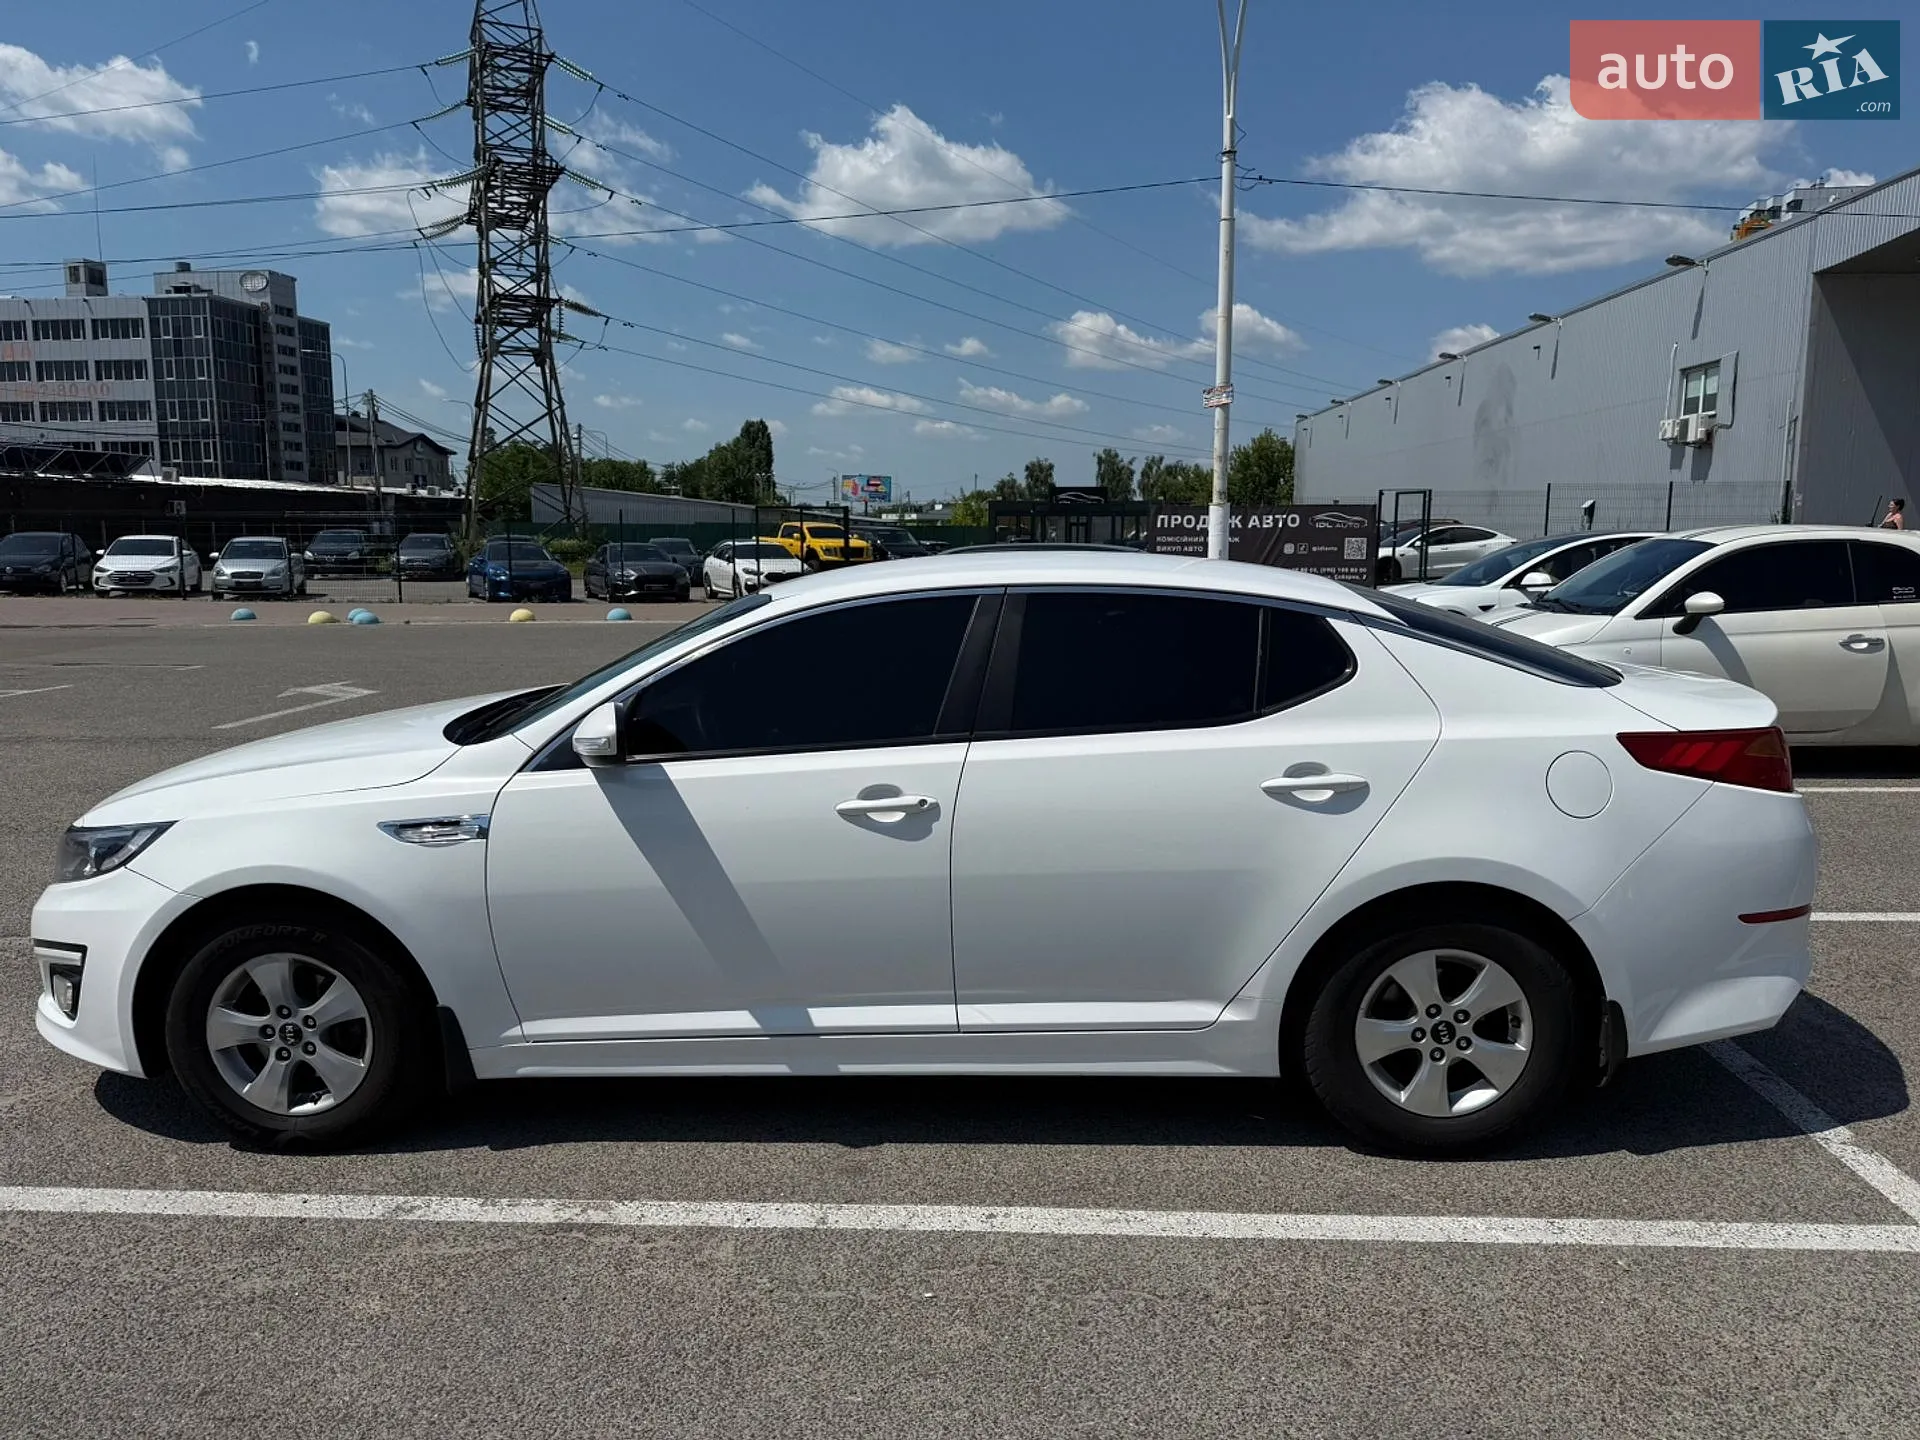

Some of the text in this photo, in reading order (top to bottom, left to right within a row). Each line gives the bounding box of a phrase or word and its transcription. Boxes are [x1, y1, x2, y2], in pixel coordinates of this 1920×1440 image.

[1156, 513, 1300, 530] ПРОДЖ АВТО
[285, 1025, 296, 1046] KIA
